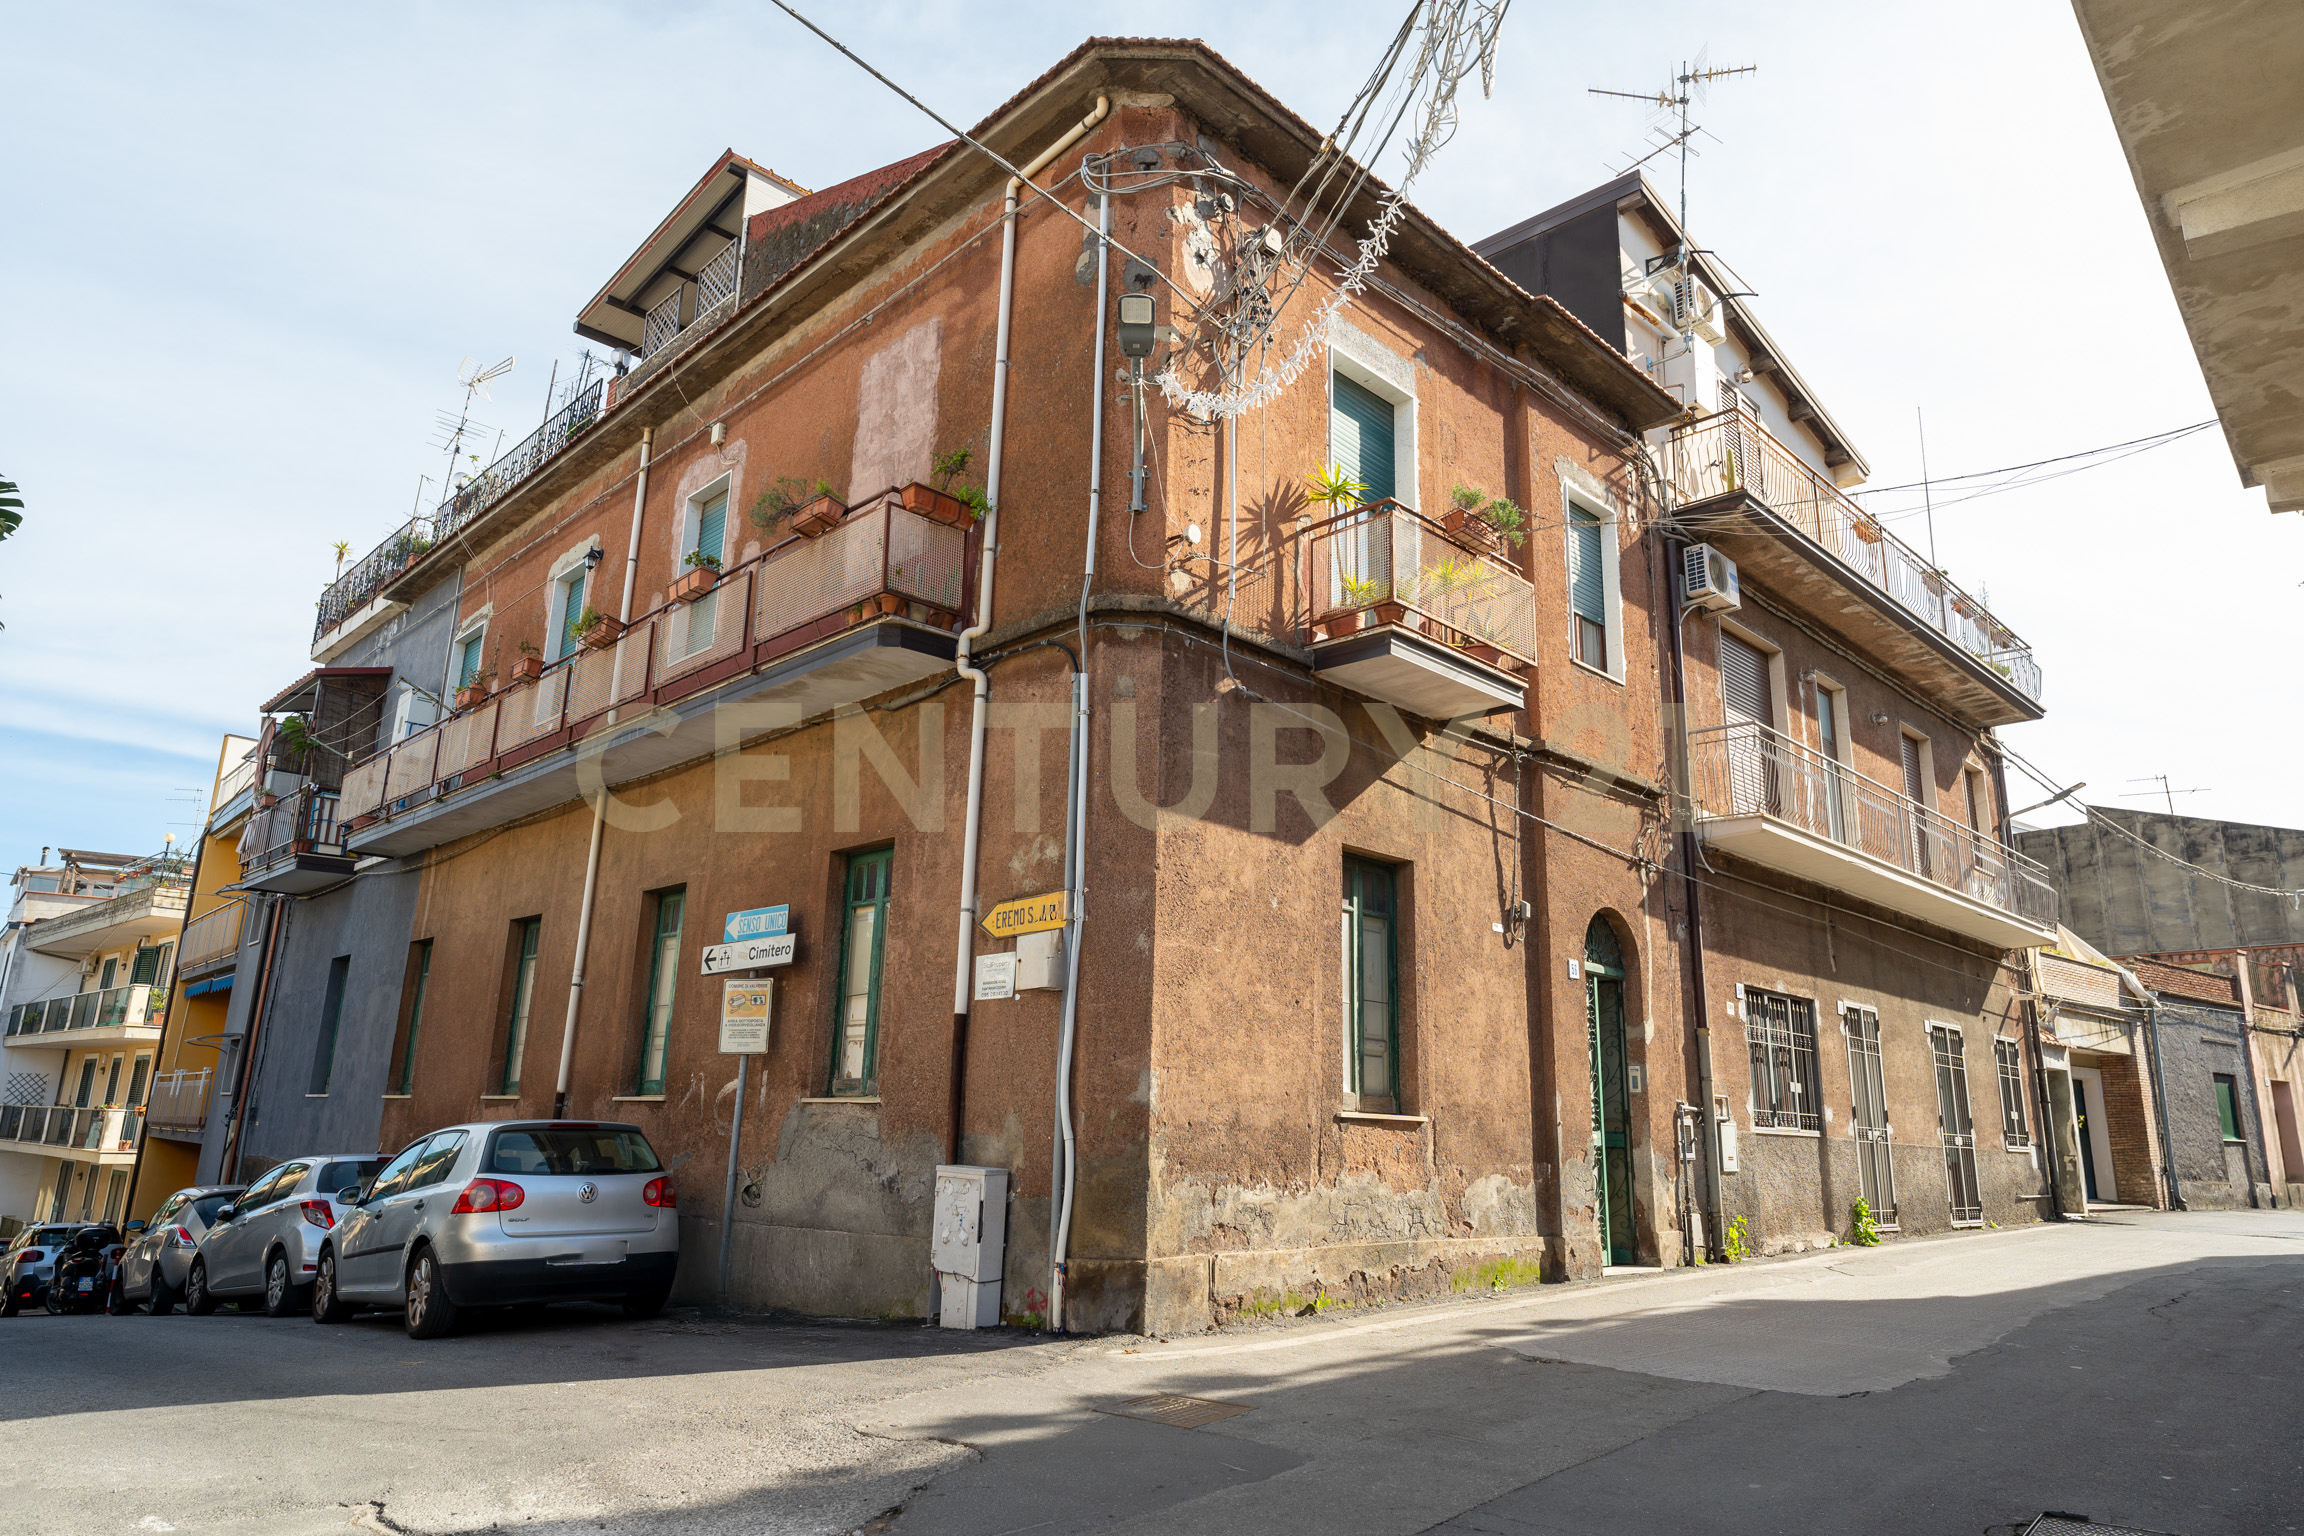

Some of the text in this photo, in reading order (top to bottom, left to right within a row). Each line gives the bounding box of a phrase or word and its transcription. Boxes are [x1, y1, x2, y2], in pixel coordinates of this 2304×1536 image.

[738, 913, 787, 934] SENSO UNICO
[996, 907, 1025, 929] EREMO
[749, 945, 791, 960] Cimitero
